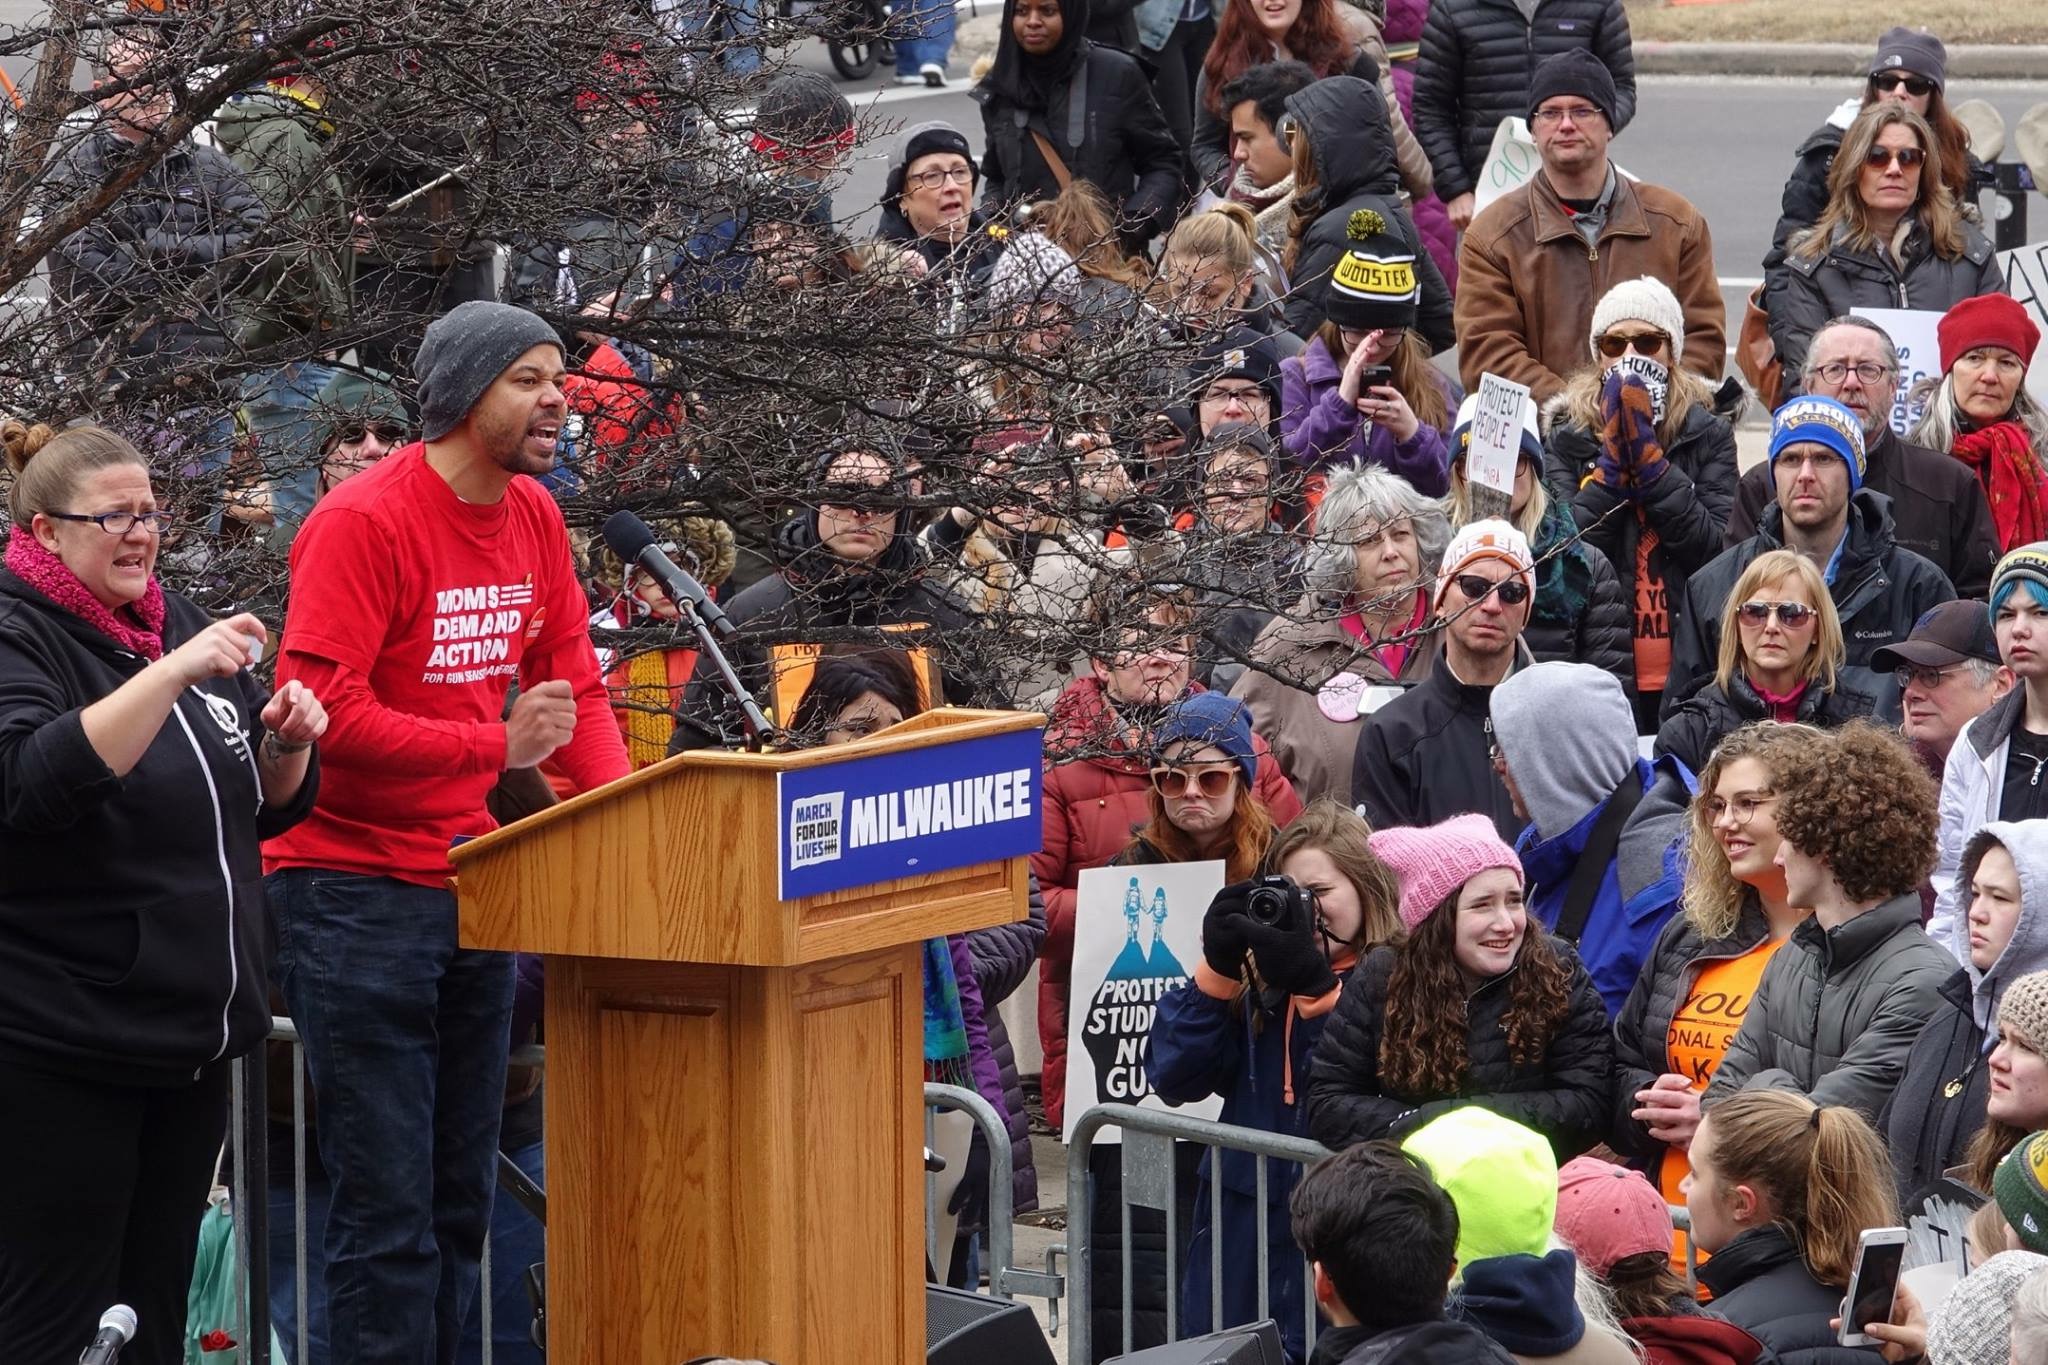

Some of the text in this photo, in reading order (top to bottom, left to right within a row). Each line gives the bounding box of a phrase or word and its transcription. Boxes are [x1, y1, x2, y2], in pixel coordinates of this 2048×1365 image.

[1340, 260, 1409, 288] WOOSTER
[1480, 378, 1523, 419] PROTECT
[1474, 410, 1510, 450] PEOPLE
[436, 585, 500, 614] MOMS
[433, 610, 521, 641] DEMAND
[426, 638, 508, 667] ACTION
[422, 672, 444, 684] FOR
[446, 671, 465, 684] GUN
[796, 801, 832, 824] MARCH
[849, 768, 1032, 848] MILWAUKEE
[796, 819, 838, 842] FOR OUR
[796, 841, 824, 860] LIVES
